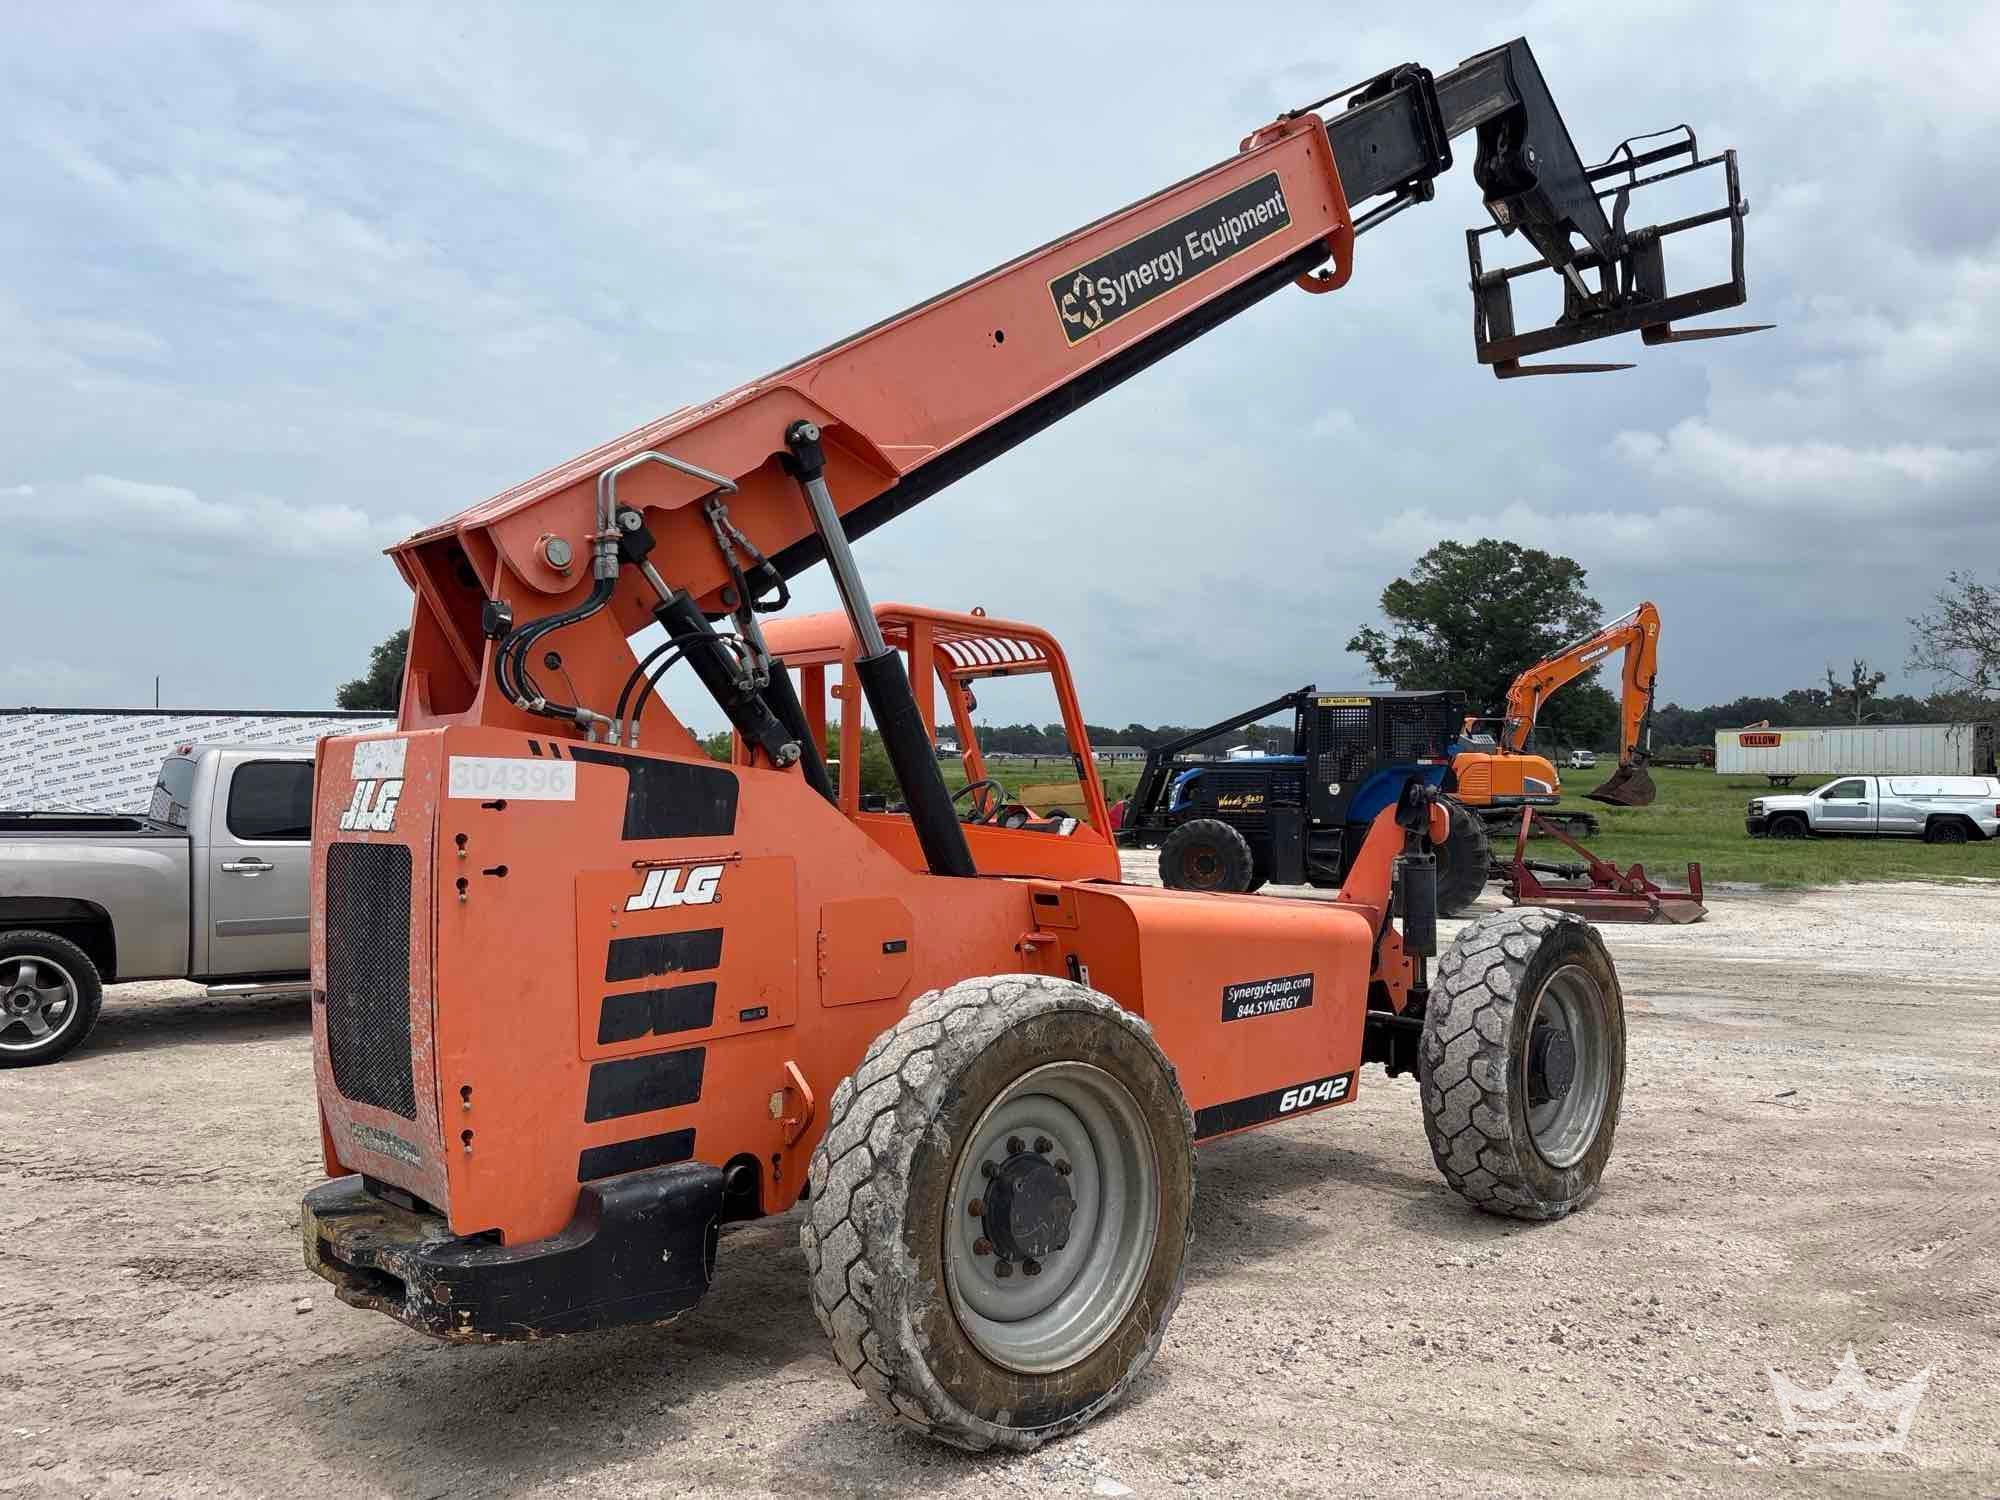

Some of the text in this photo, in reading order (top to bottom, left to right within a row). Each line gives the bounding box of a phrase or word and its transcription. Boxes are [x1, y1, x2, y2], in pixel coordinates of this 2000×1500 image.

[1097, 190, 1286, 306] Synergy Equipment
[1744, 735, 1776, 745] YELLOW
[453, 762, 569, 793] 304396
[338, 778, 405, 832] JLG
[624, 864, 725, 912] JLG
[1227, 975, 1311, 1002] SynergyEquip.com
[1237, 995, 1300, 1018] 844.SYNERGY
[1279, 1077, 1348, 1112] 6042
